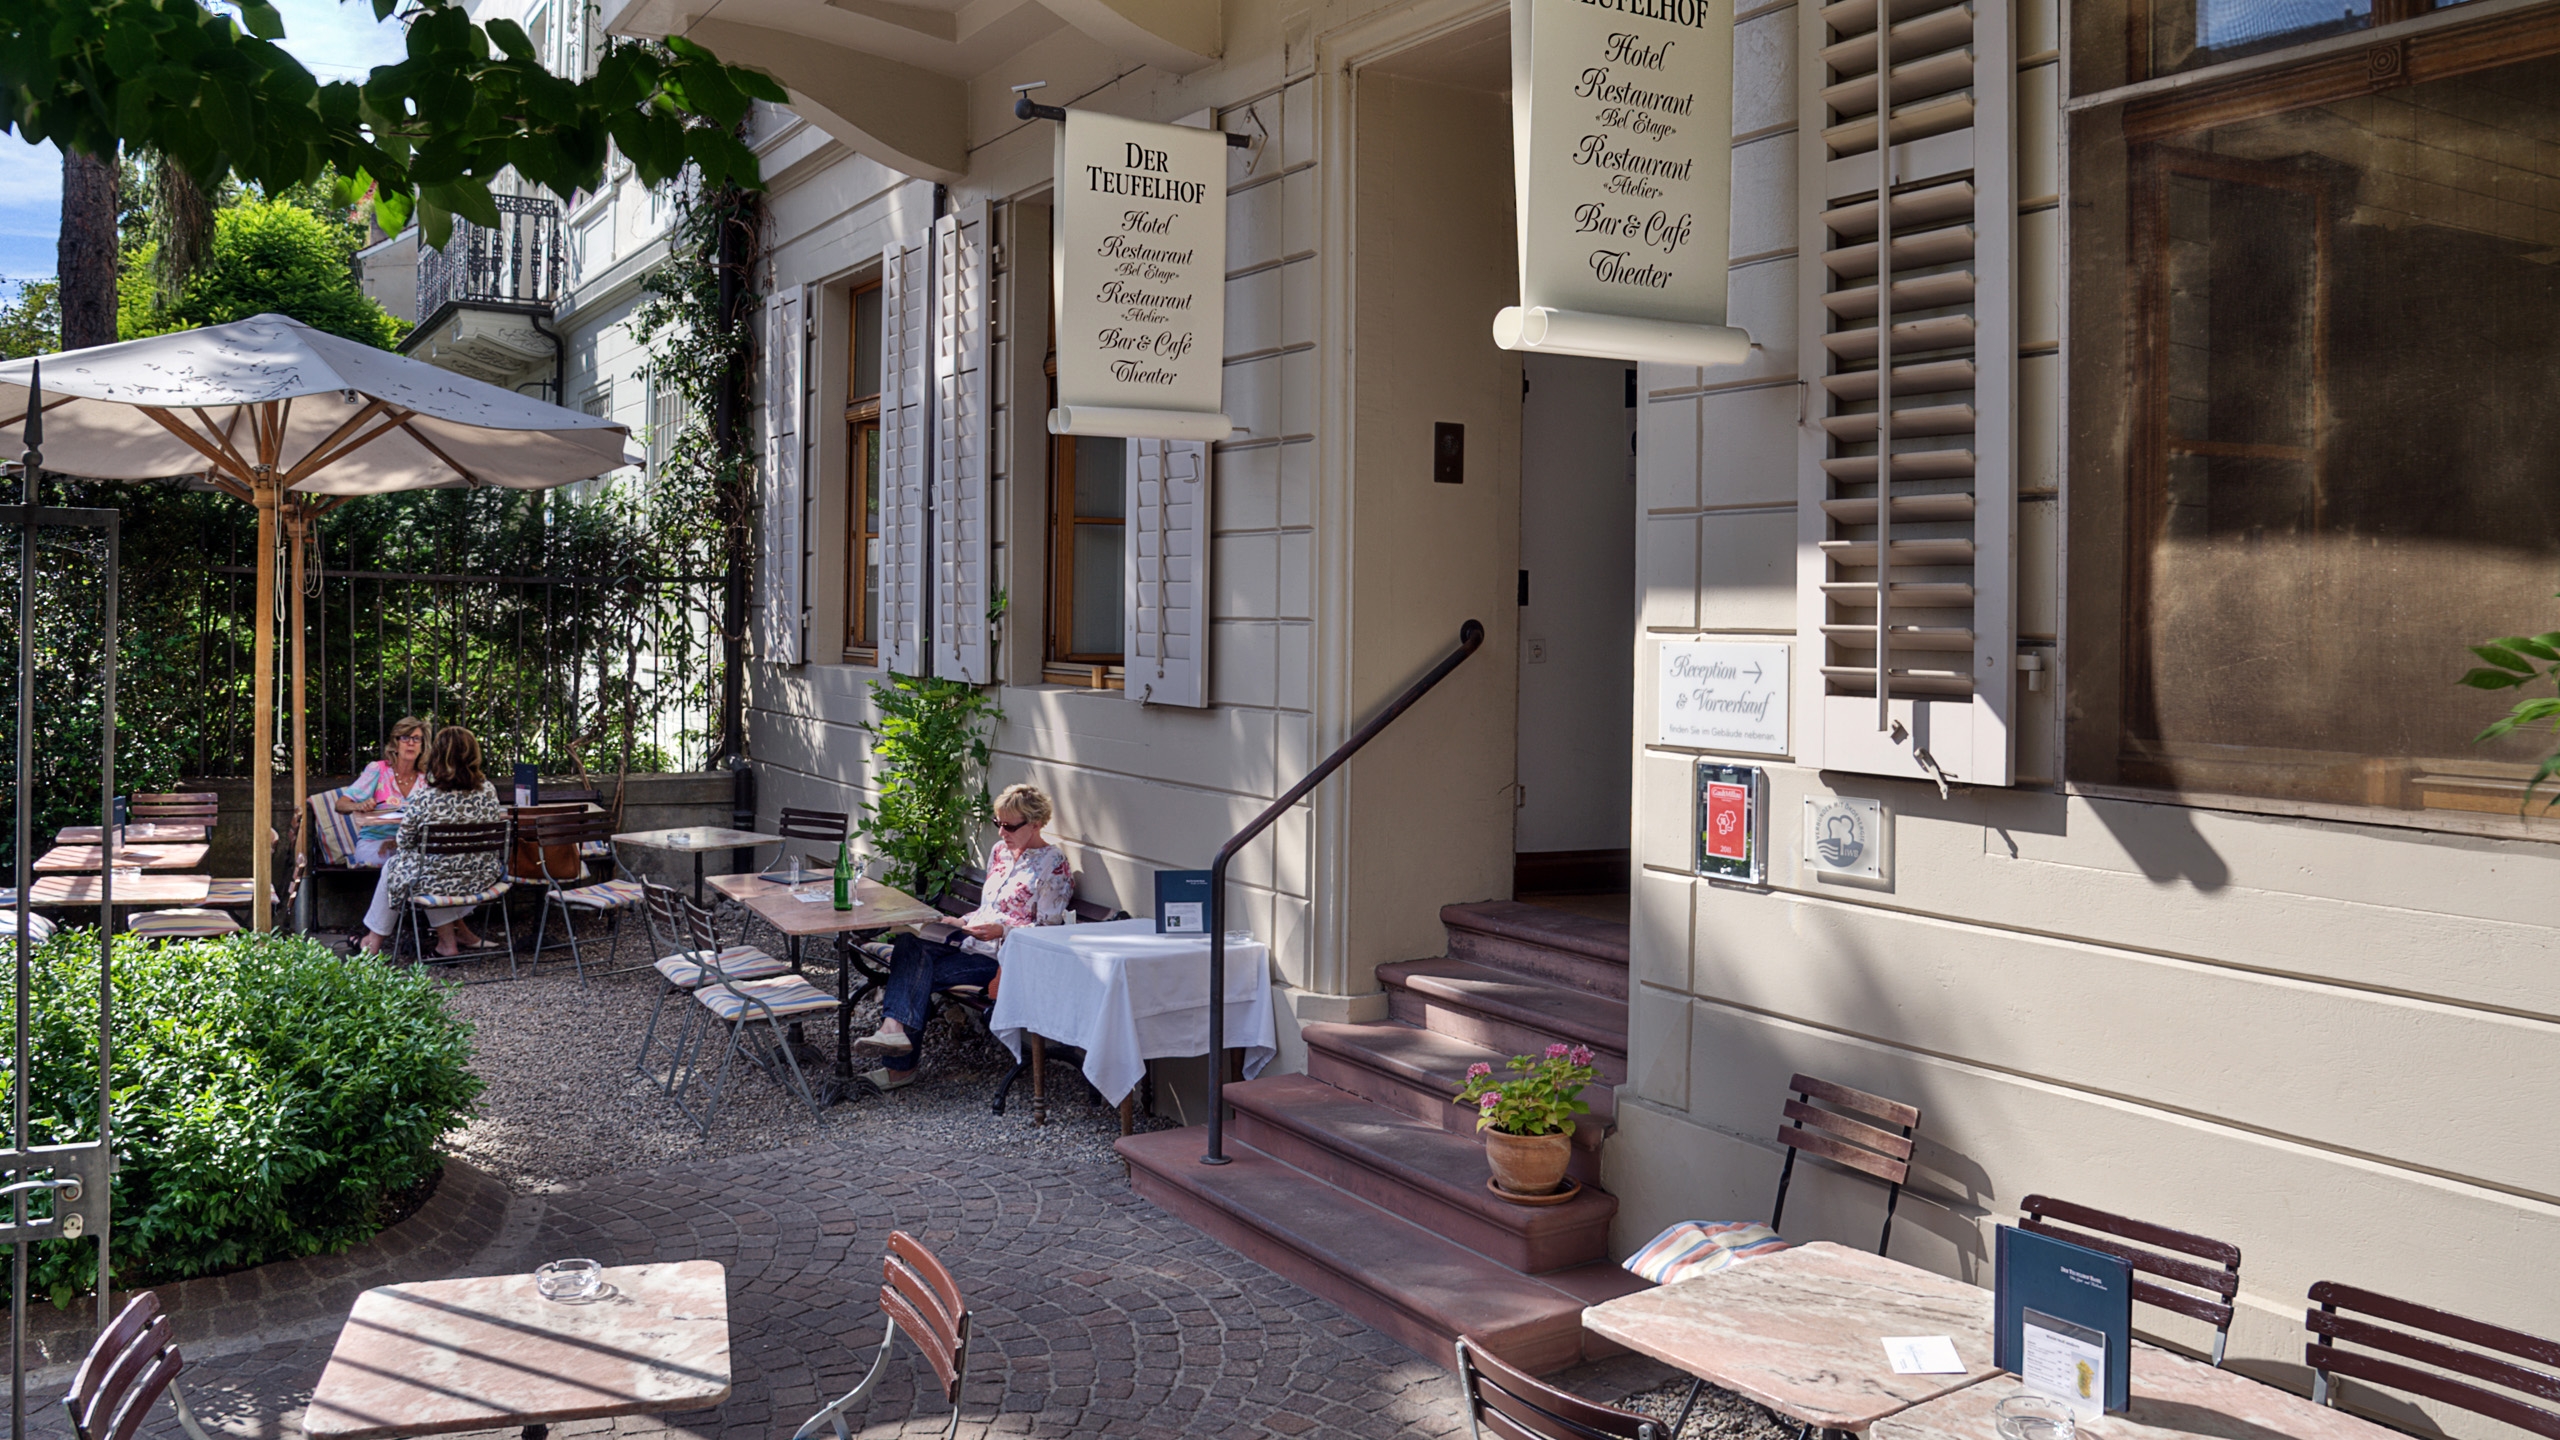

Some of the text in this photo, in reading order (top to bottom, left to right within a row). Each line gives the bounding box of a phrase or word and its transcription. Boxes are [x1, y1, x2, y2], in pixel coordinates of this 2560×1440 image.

[1604, 32, 1675, 72] Hotel
[1574, 67, 1694, 117] Restaurant
[1125, 142, 1169, 173] DER
[1572, 134, 1693, 182] Restaurant
[1086, 165, 1206, 204] TEUFELHOF
[1121, 210, 1178, 235] Hotel
[1574, 202, 1692, 254] Bar & Café
[1097, 235, 1193, 265] Restaurant
[1589, 249, 1673, 289] Theater
[1096, 281, 1192, 310] Restaurant
[1099, 327, 1192, 360] Bar & Café
[1110, 359, 1177, 385] Theater
[1669, 654, 1737, 685] Reception
[1676, 688, 1776, 723] & Vorverkauf
[1669, 724, 1776, 741] finden Sie im Gebäude nebenan.
